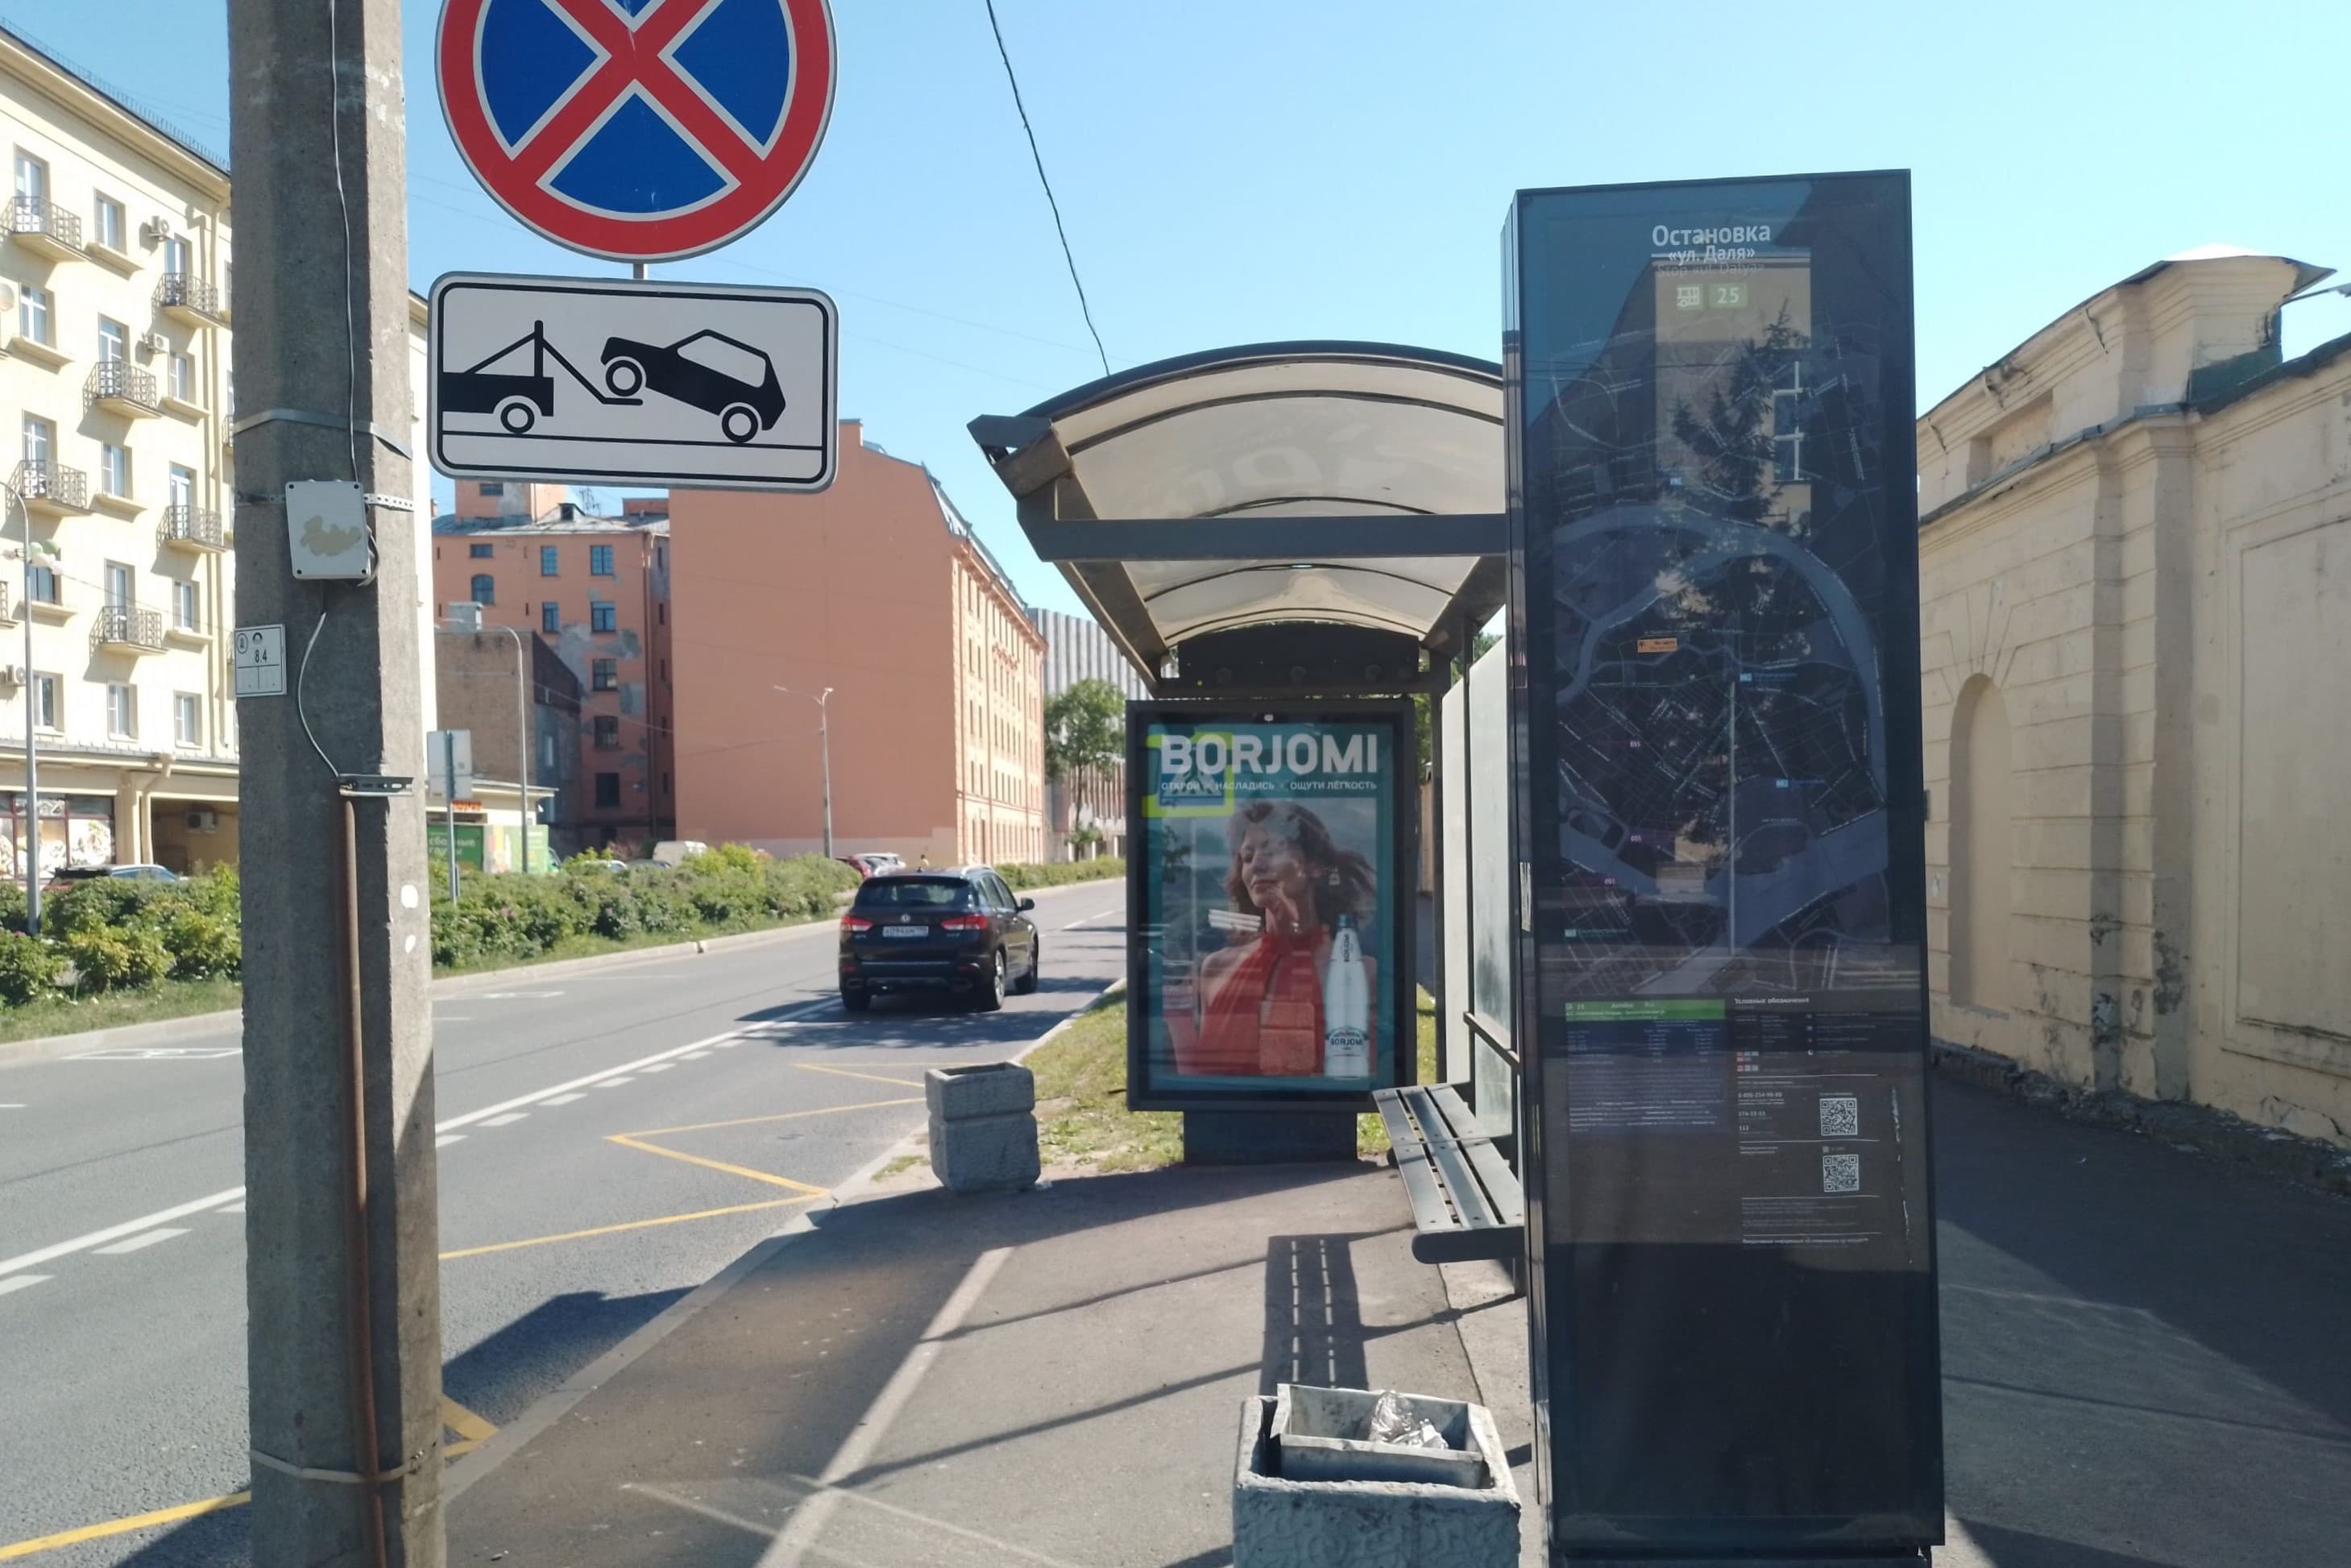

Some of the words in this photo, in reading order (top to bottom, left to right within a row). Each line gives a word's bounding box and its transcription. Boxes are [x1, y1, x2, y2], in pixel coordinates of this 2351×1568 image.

[1652, 223, 1771, 247] Остановка
[1668, 249, 1700, 266] «ул.
[1704, 245, 1756, 263] Даля»
[1717, 287, 1739, 305] 25
[255, 649, 267, 664] 8.4
[1161, 734, 1377, 775] BORJOMI
[1215, 781, 1275, 790] НАСЛАДИСЬ
[1290, 781, 1325, 790] ОЩУТИ
